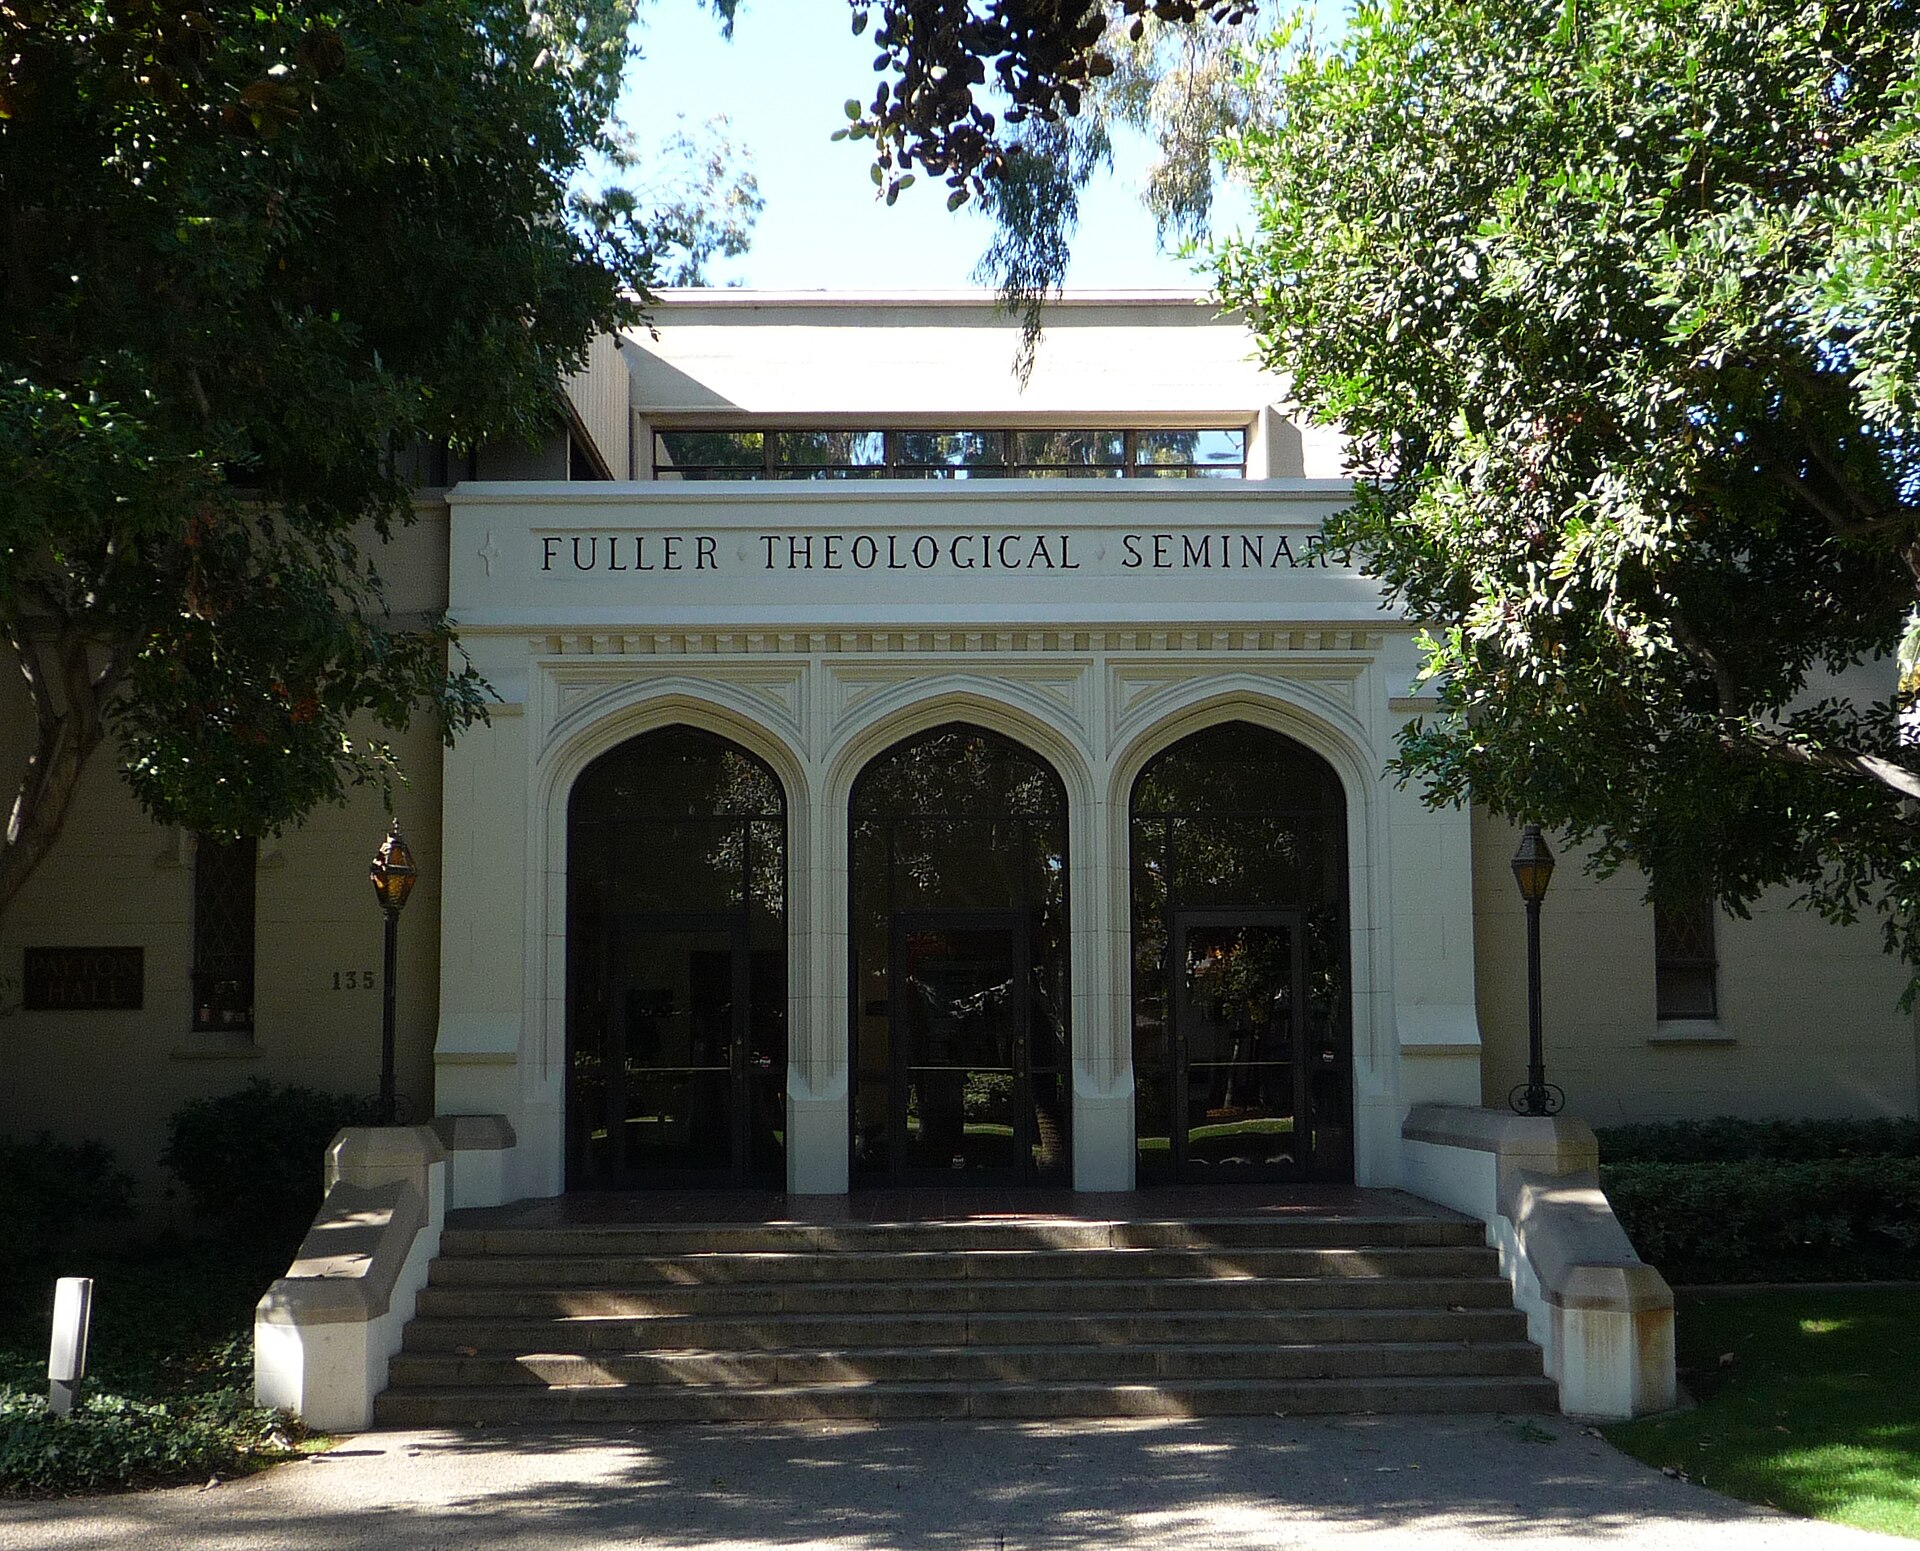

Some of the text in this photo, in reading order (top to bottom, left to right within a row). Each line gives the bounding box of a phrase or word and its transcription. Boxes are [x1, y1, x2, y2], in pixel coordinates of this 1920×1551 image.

[541, 536, 719, 570] FULLER
[759, 534, 1081, 569] THEOLOGICAL
[47, 979, 126, 1003] HALL
[333, 971, 374, 990] 135
